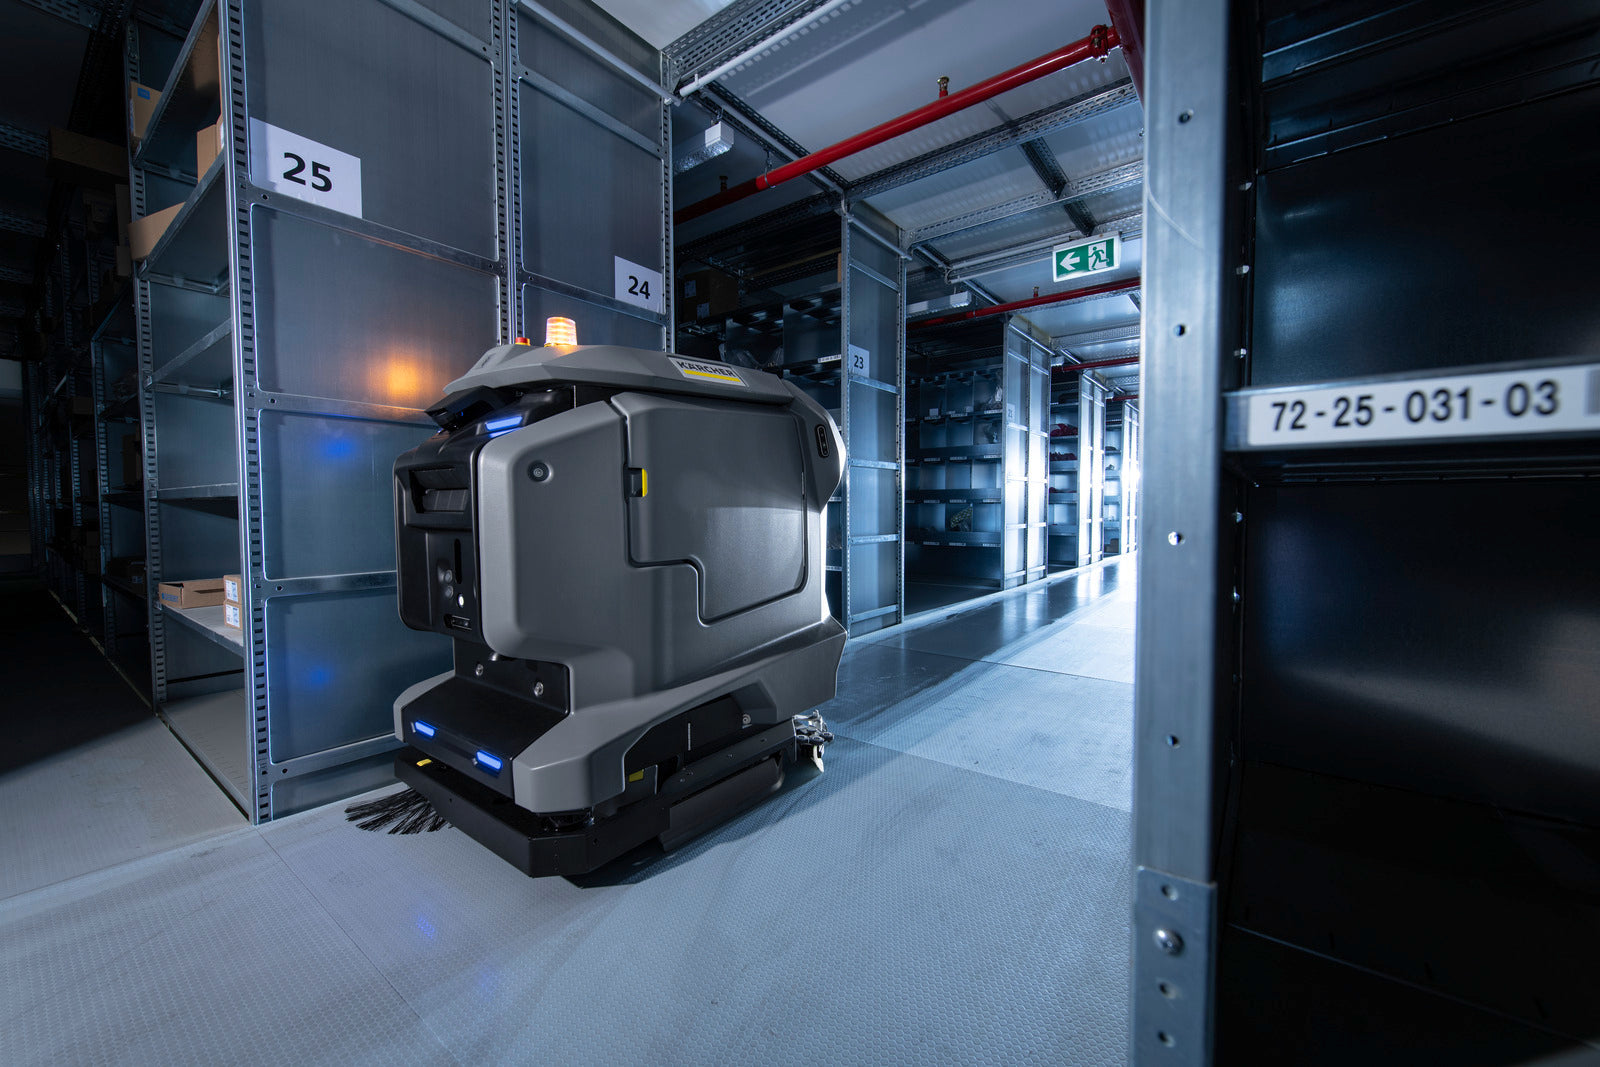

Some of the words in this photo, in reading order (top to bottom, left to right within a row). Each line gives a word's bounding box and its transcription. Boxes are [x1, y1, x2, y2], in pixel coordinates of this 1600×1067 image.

[283, 152, 332, 192] 25
[628, 275, 650, 299] 24
[854, 355, 864, 369] 23
